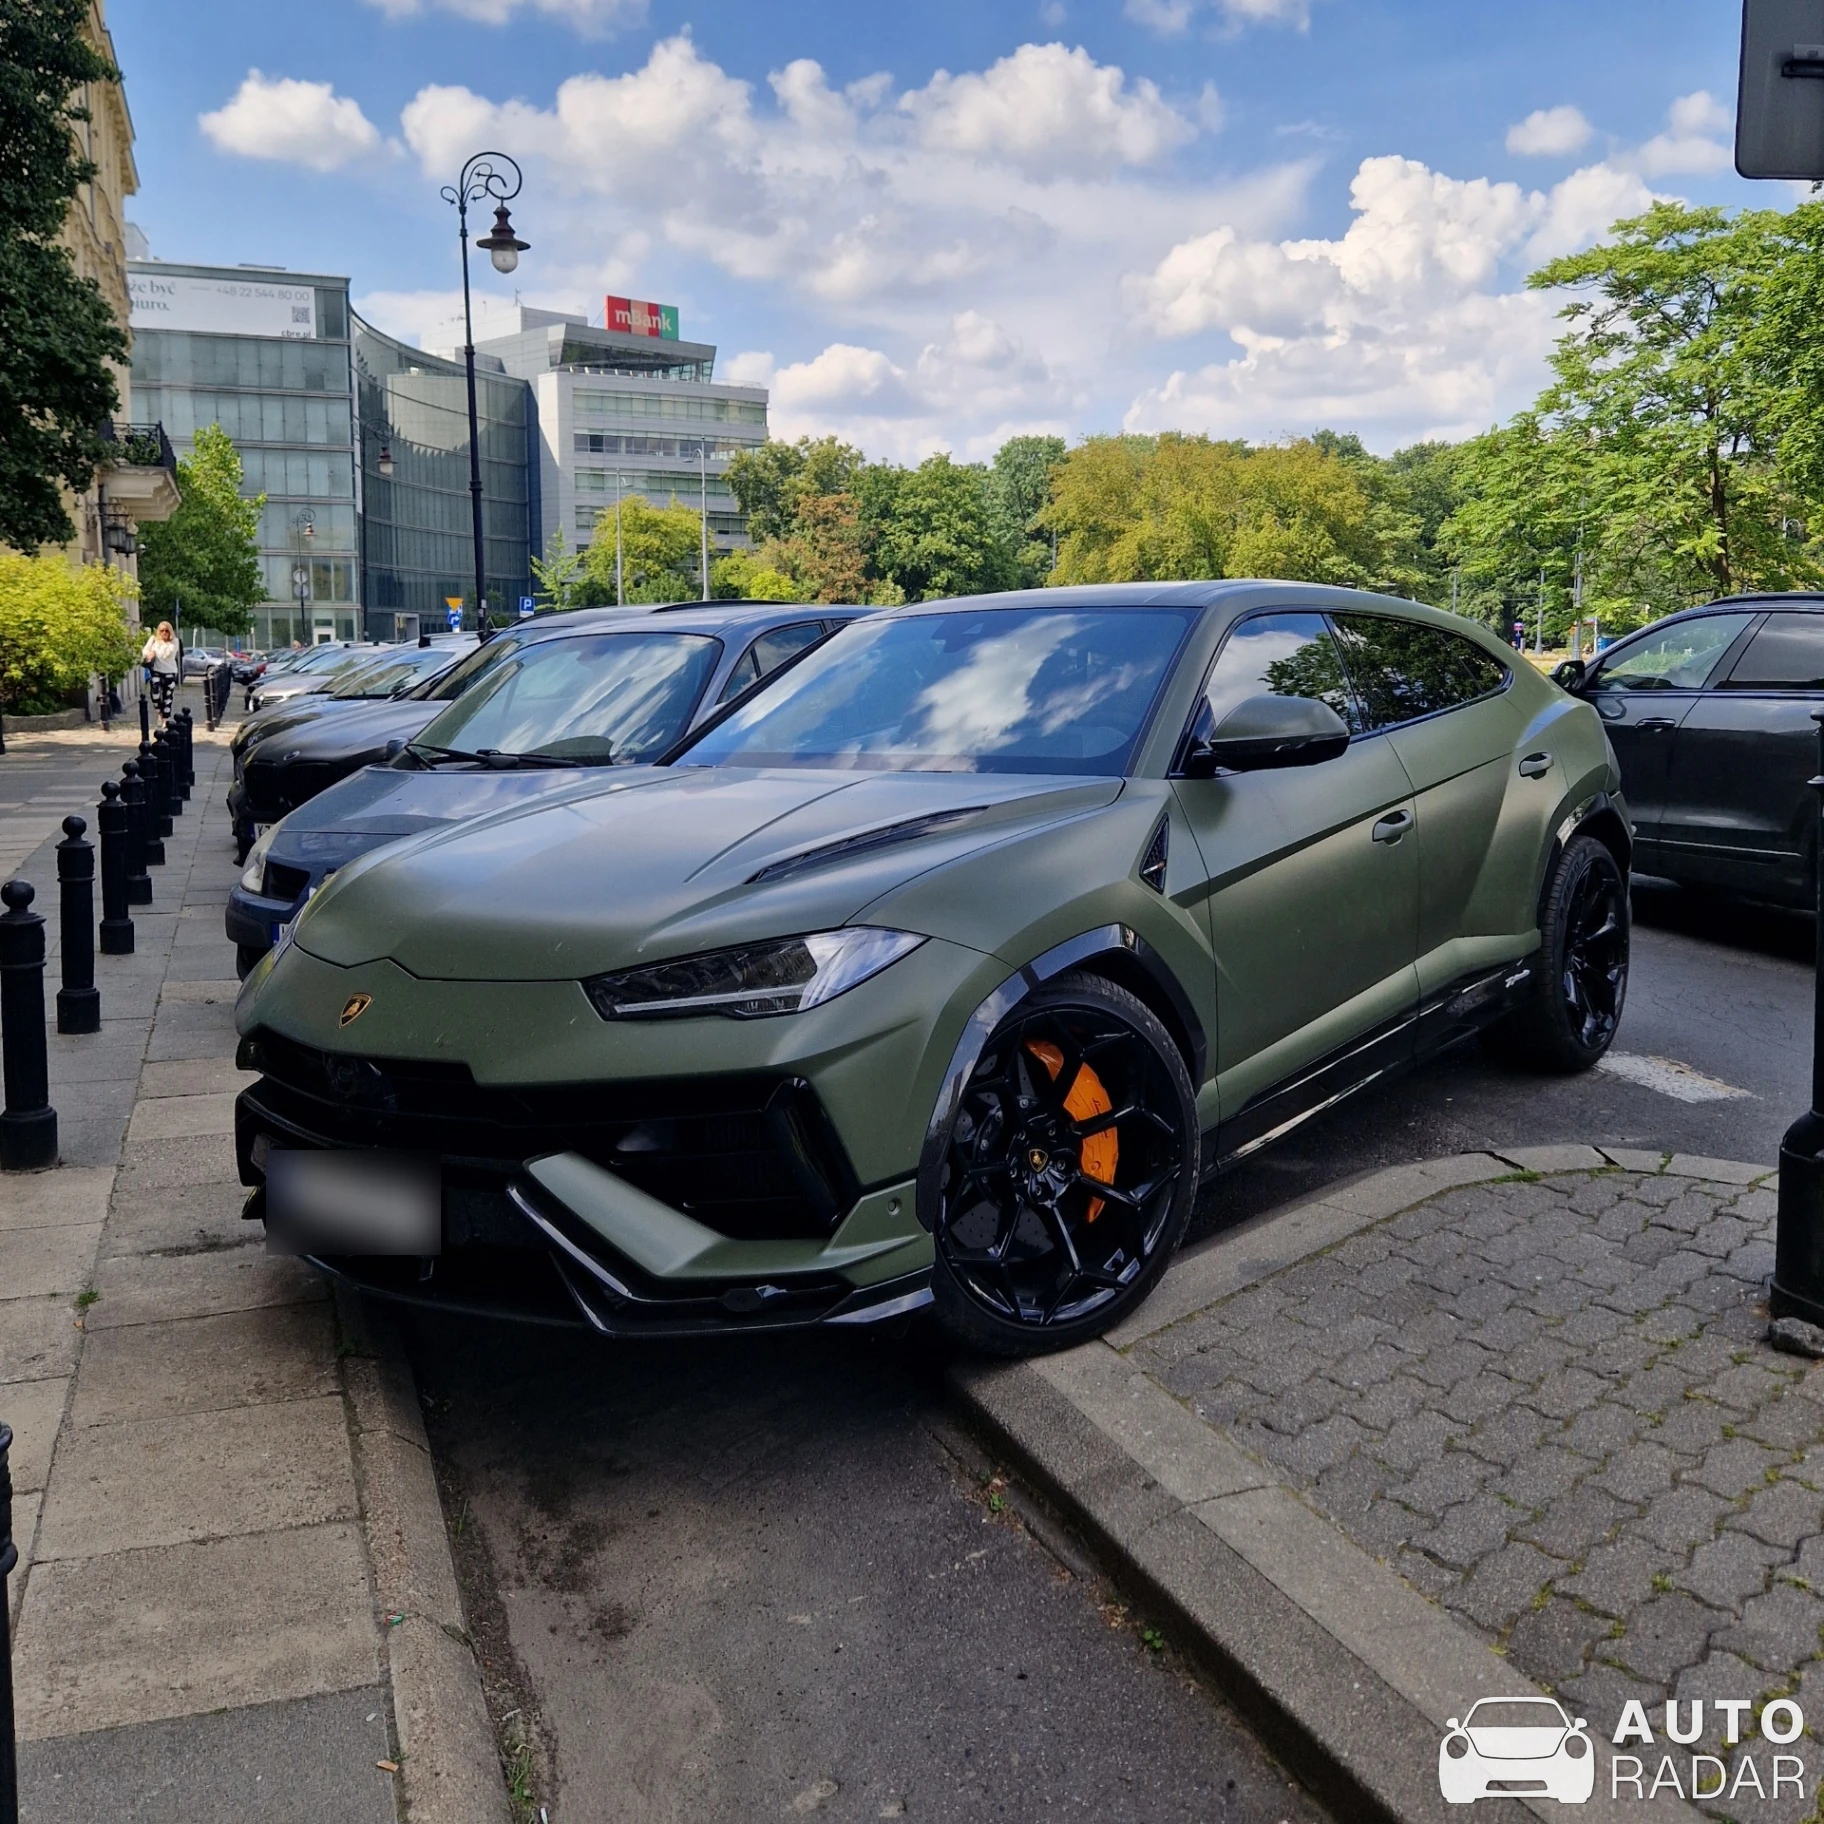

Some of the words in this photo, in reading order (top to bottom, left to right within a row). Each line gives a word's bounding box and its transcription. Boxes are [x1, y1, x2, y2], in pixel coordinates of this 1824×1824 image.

[239, 287, 252, 298] 22
[255, 288, 275, 299] 544
[278, 290, 292, 300] 80
[295, 291, 310, 301] 00
[615, 308, 672, 331] mBank
[281, 329, 311, 338] cbre.pl
[523, 599, 532, 609] P
